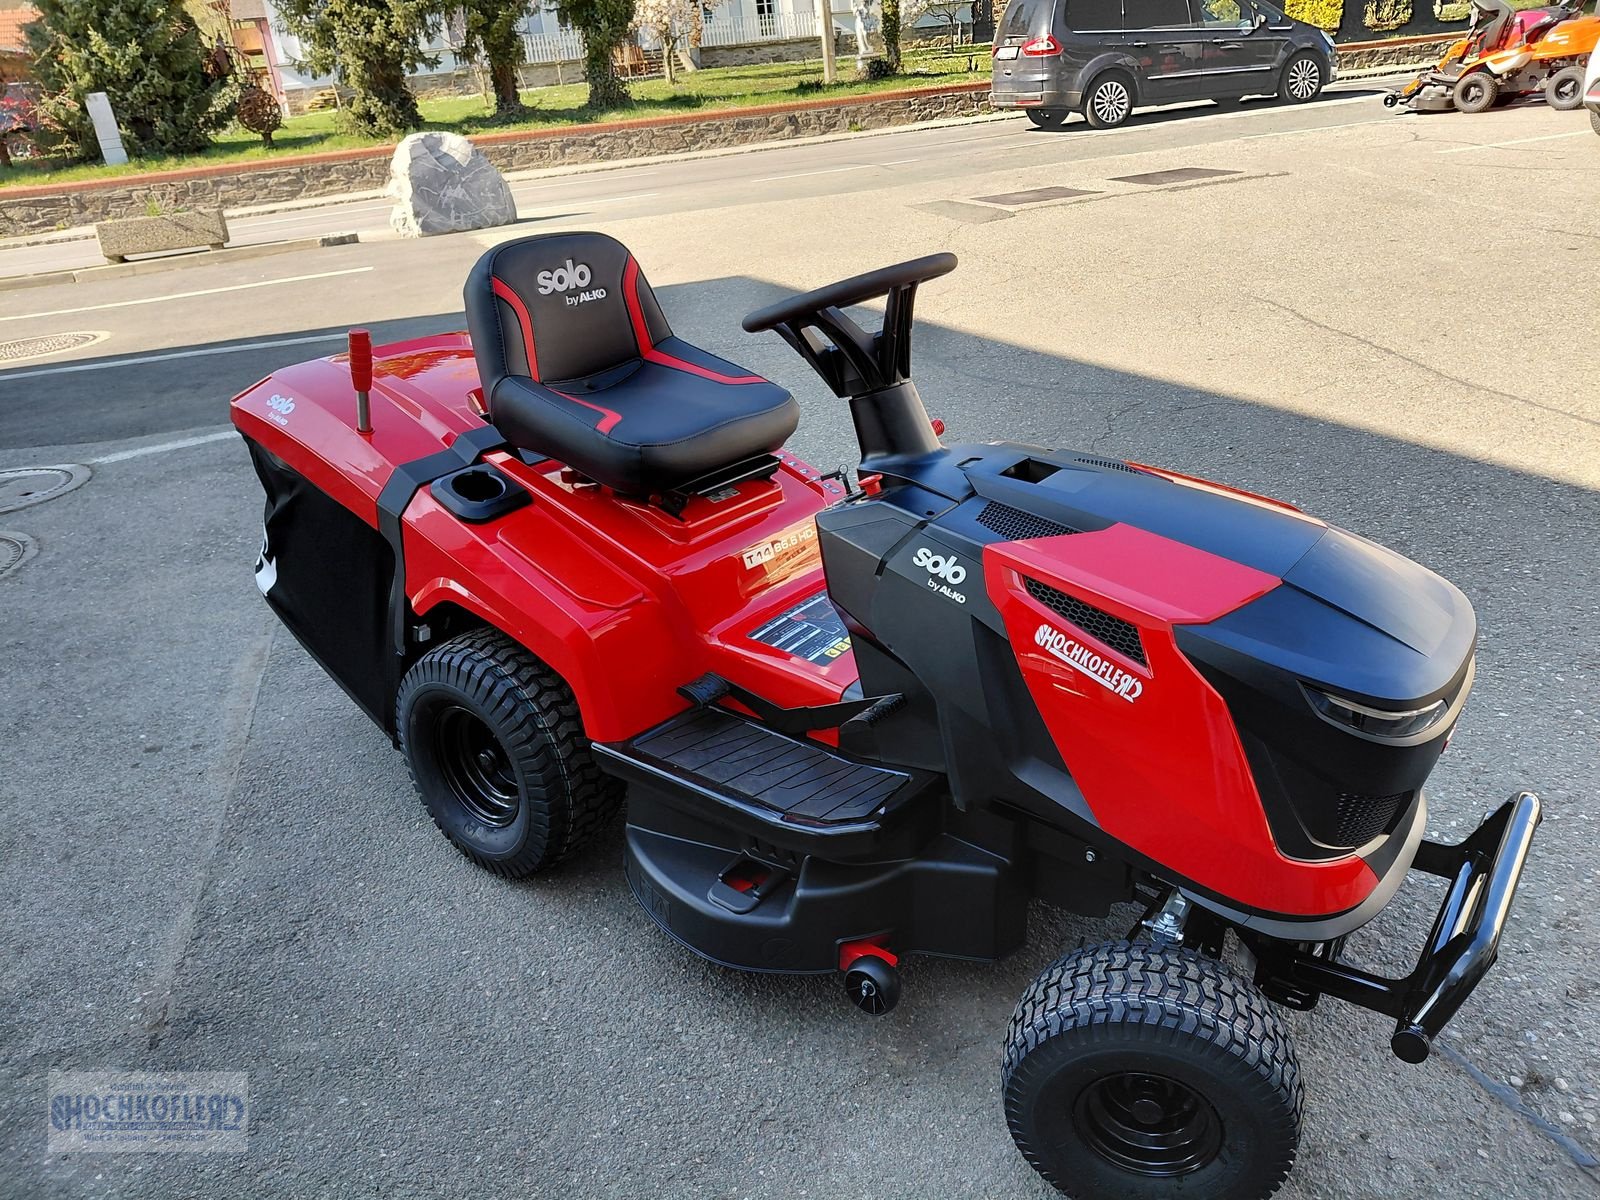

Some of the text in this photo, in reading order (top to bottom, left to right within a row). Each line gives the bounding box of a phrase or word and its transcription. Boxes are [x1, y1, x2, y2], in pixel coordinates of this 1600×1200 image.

[537, 259, 592, 295] solo
[565, 296, 579, 306] by
[266, 394, 296, 415] solo
[912, 547, 967, 585] solo
[927, 578, 940, 592] by
[1036, 624, 1140, 701] HOCHKOFLER
